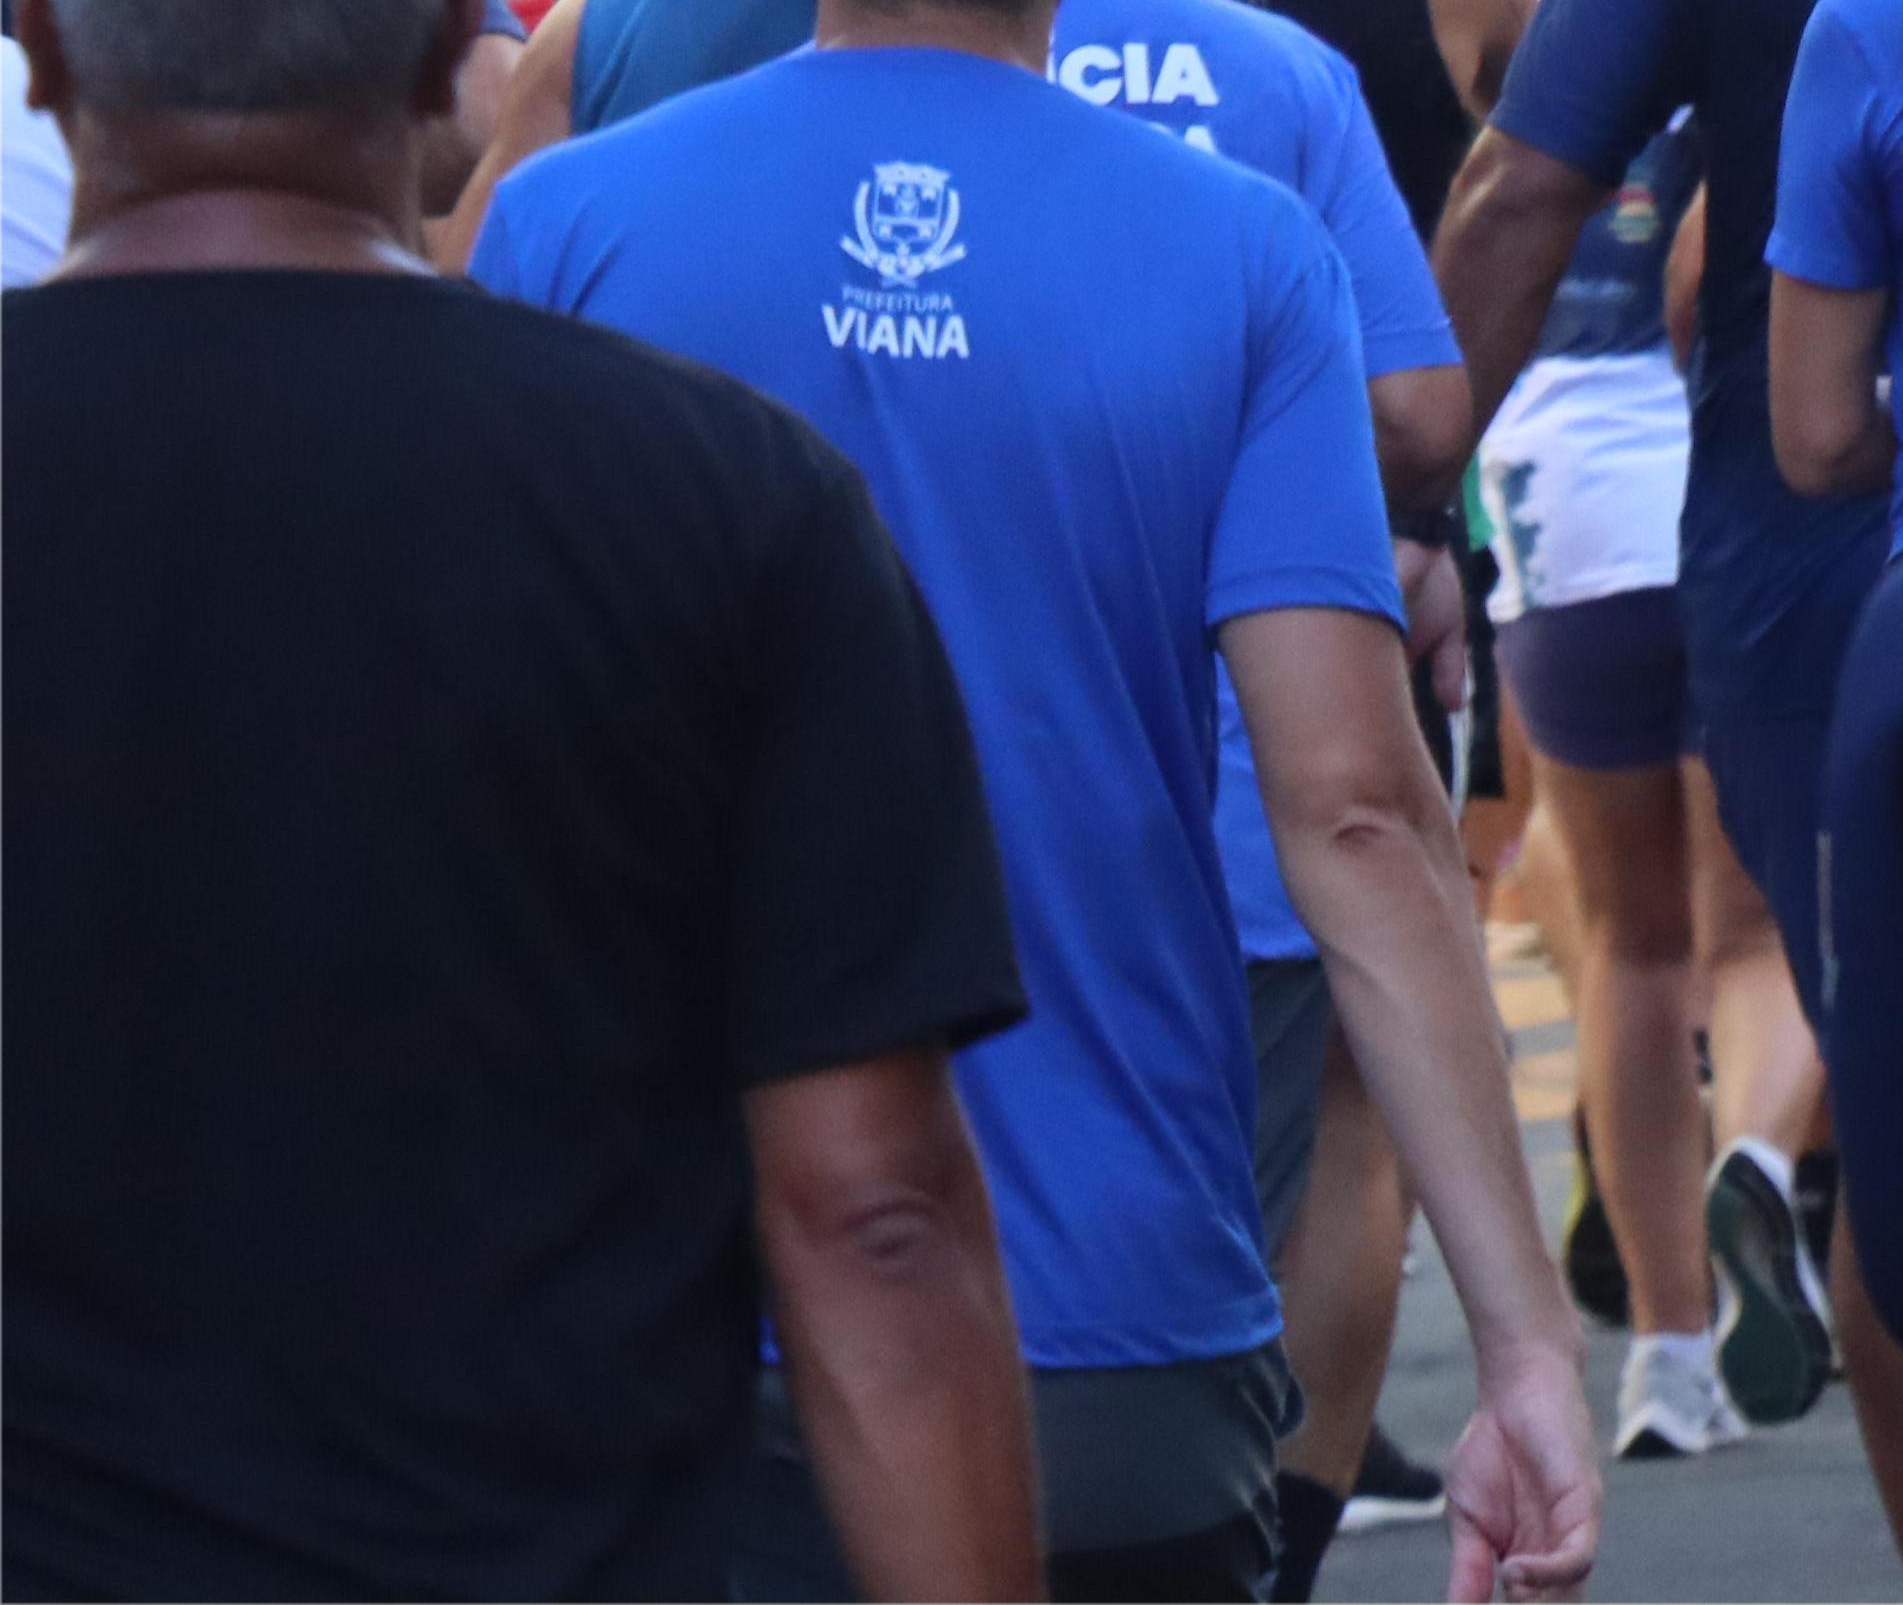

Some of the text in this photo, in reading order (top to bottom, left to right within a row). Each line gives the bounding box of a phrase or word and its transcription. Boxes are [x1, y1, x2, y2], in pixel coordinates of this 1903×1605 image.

[1047, 42, 1221, 107] CIA
[842, 284, 955, 312] PREFEITURA
[821, 303, 970, 360] VIANA
